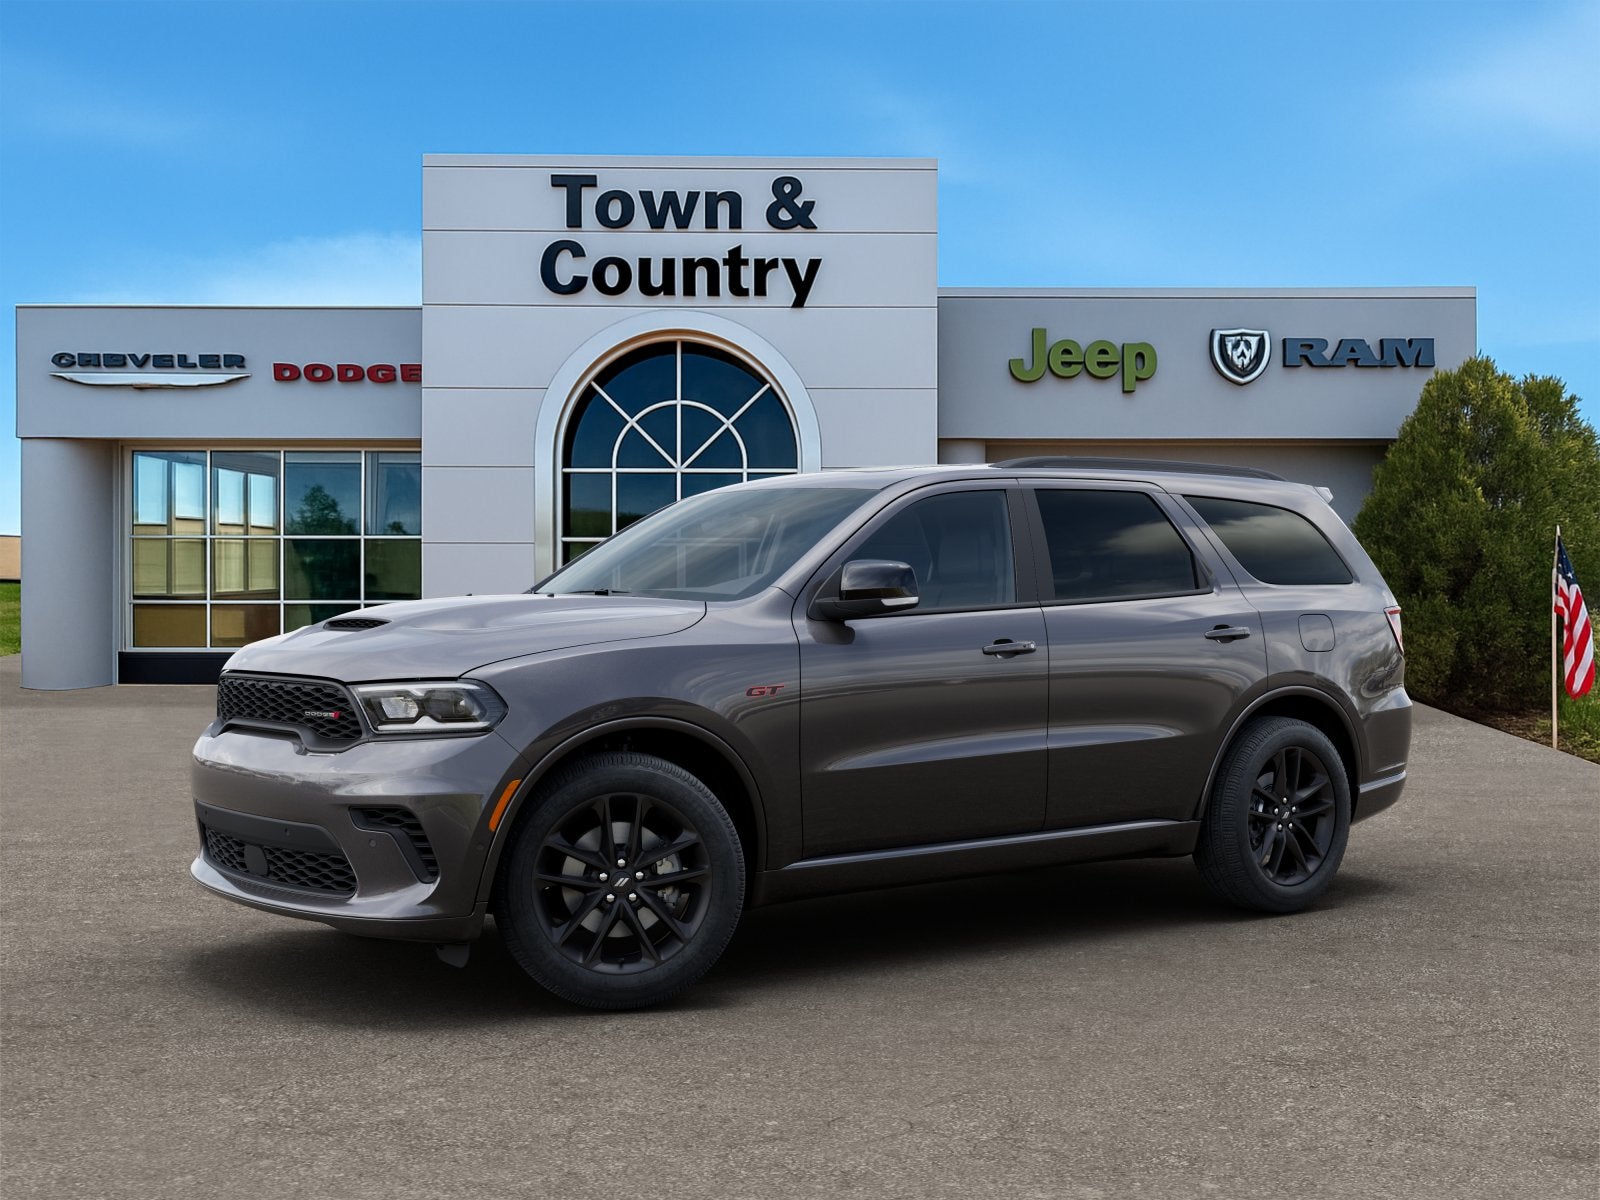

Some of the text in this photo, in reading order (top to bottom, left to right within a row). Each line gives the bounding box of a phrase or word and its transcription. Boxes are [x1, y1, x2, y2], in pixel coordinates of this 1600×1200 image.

[550, 174, 818, 229] Town &
[540, 239, 822, 308] Country
[273, 363, 422, 383] DODGE
[1008, 328, 1157, 393] Jeep
[1282, 338, 1435, 367] RAM
[746, 685, 785, 697] GT
